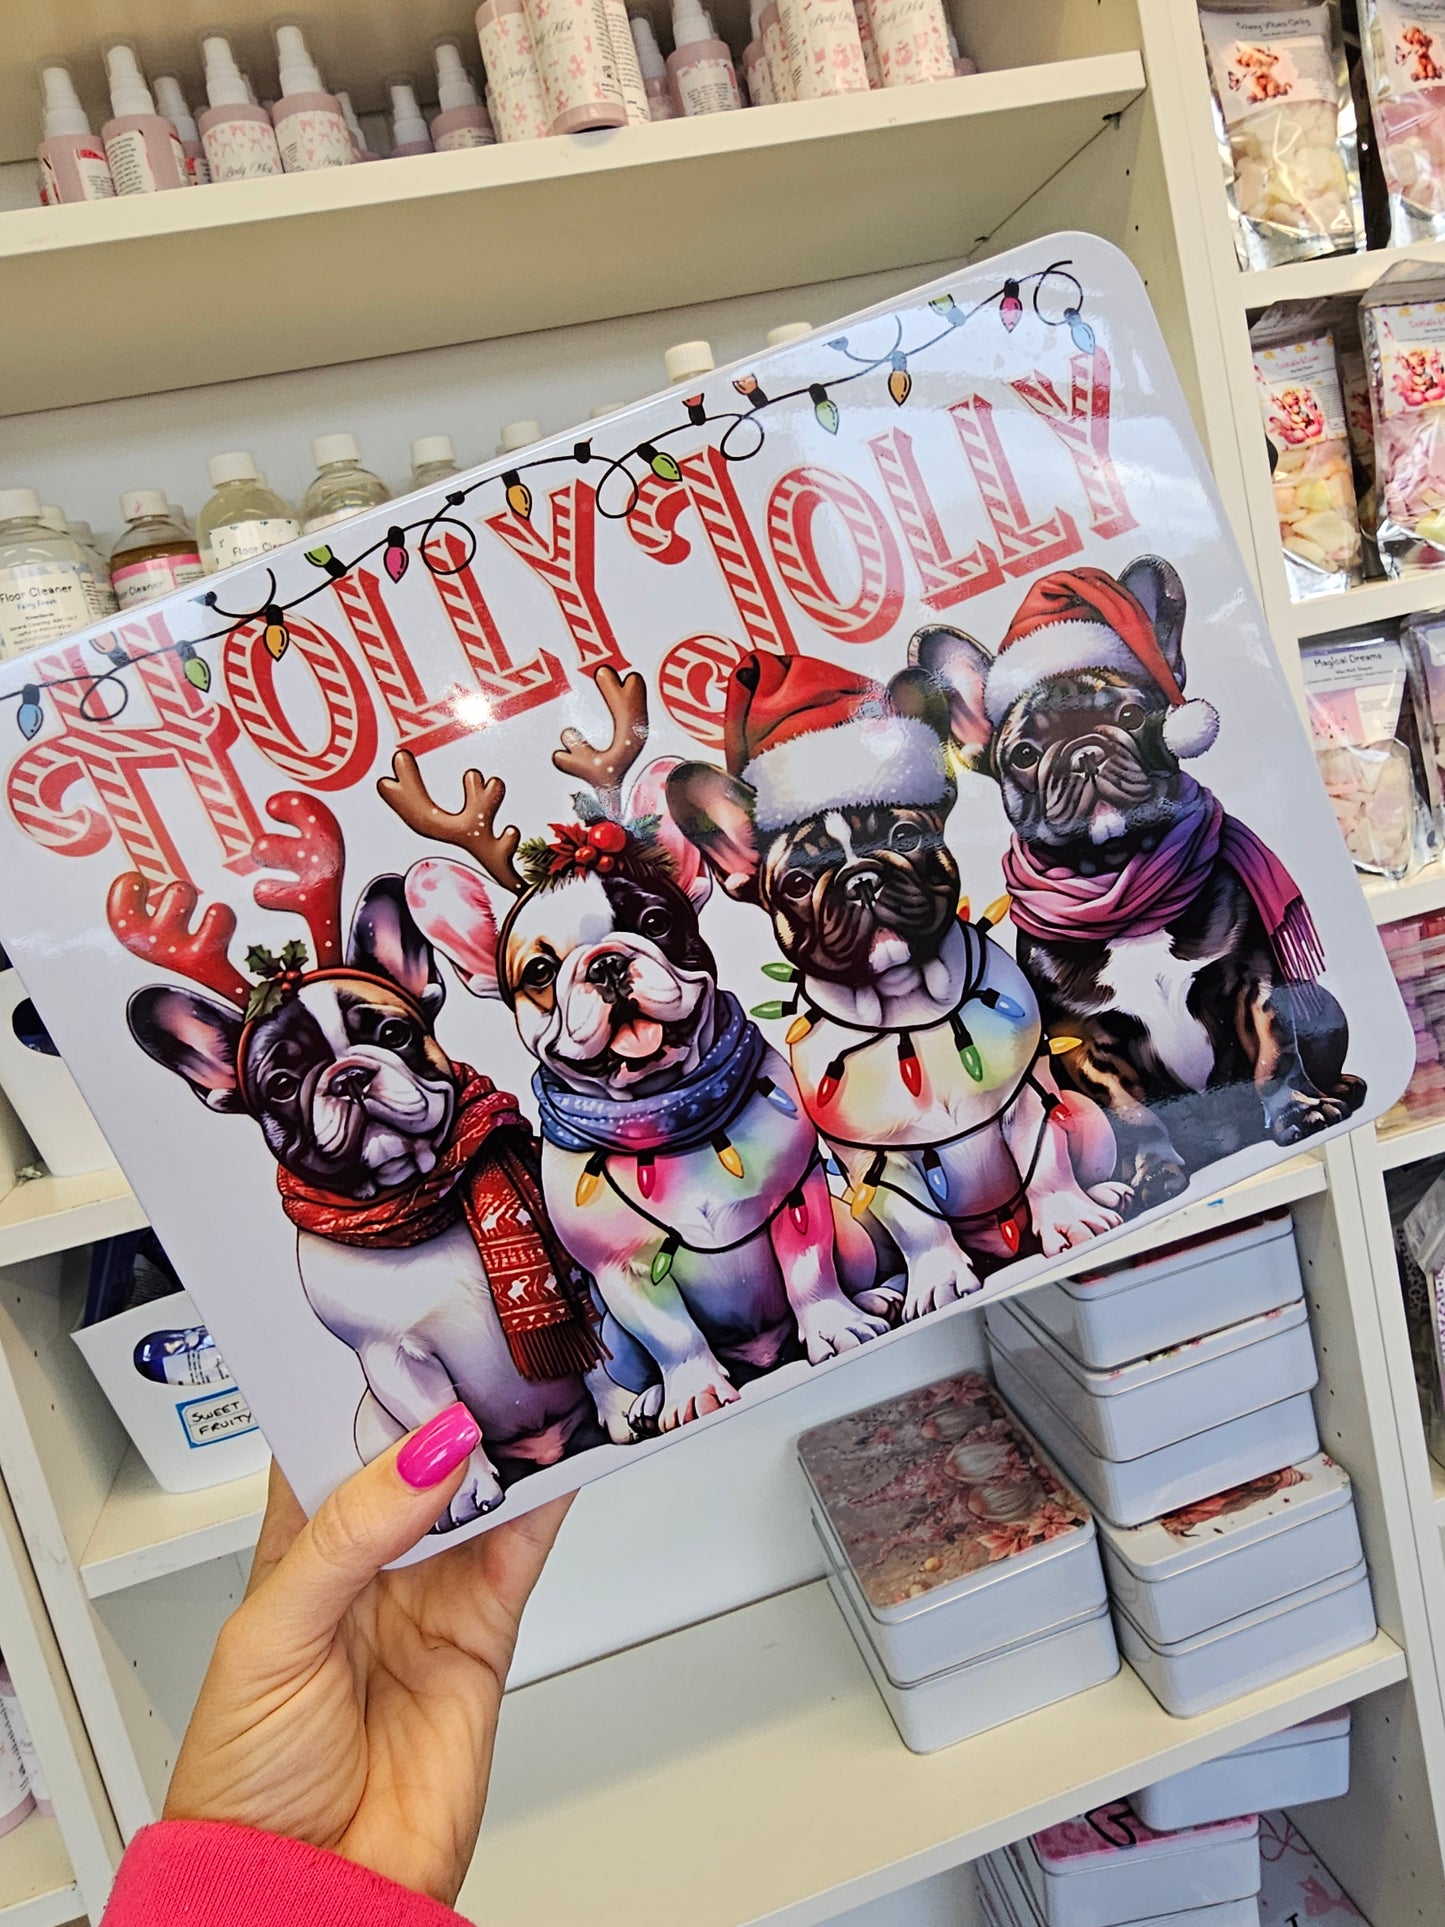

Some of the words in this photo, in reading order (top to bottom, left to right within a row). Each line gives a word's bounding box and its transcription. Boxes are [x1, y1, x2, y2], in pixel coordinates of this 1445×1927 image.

[232, 545, 259, 558] Floor
[623, 345, 1139, 750] JOLLY
[0, 591, 26, 604] Floor
[29, 584, 73, 598] Cleaner
[128, 581, 165, 597] Cleaner
[1313, 655, 1348, 670] Magical
[1349, 652, 1383, 664] Dreams
[191, 1400, 240, 1423] SWEET
[199, 1411, 252, 1436] FRUITY
